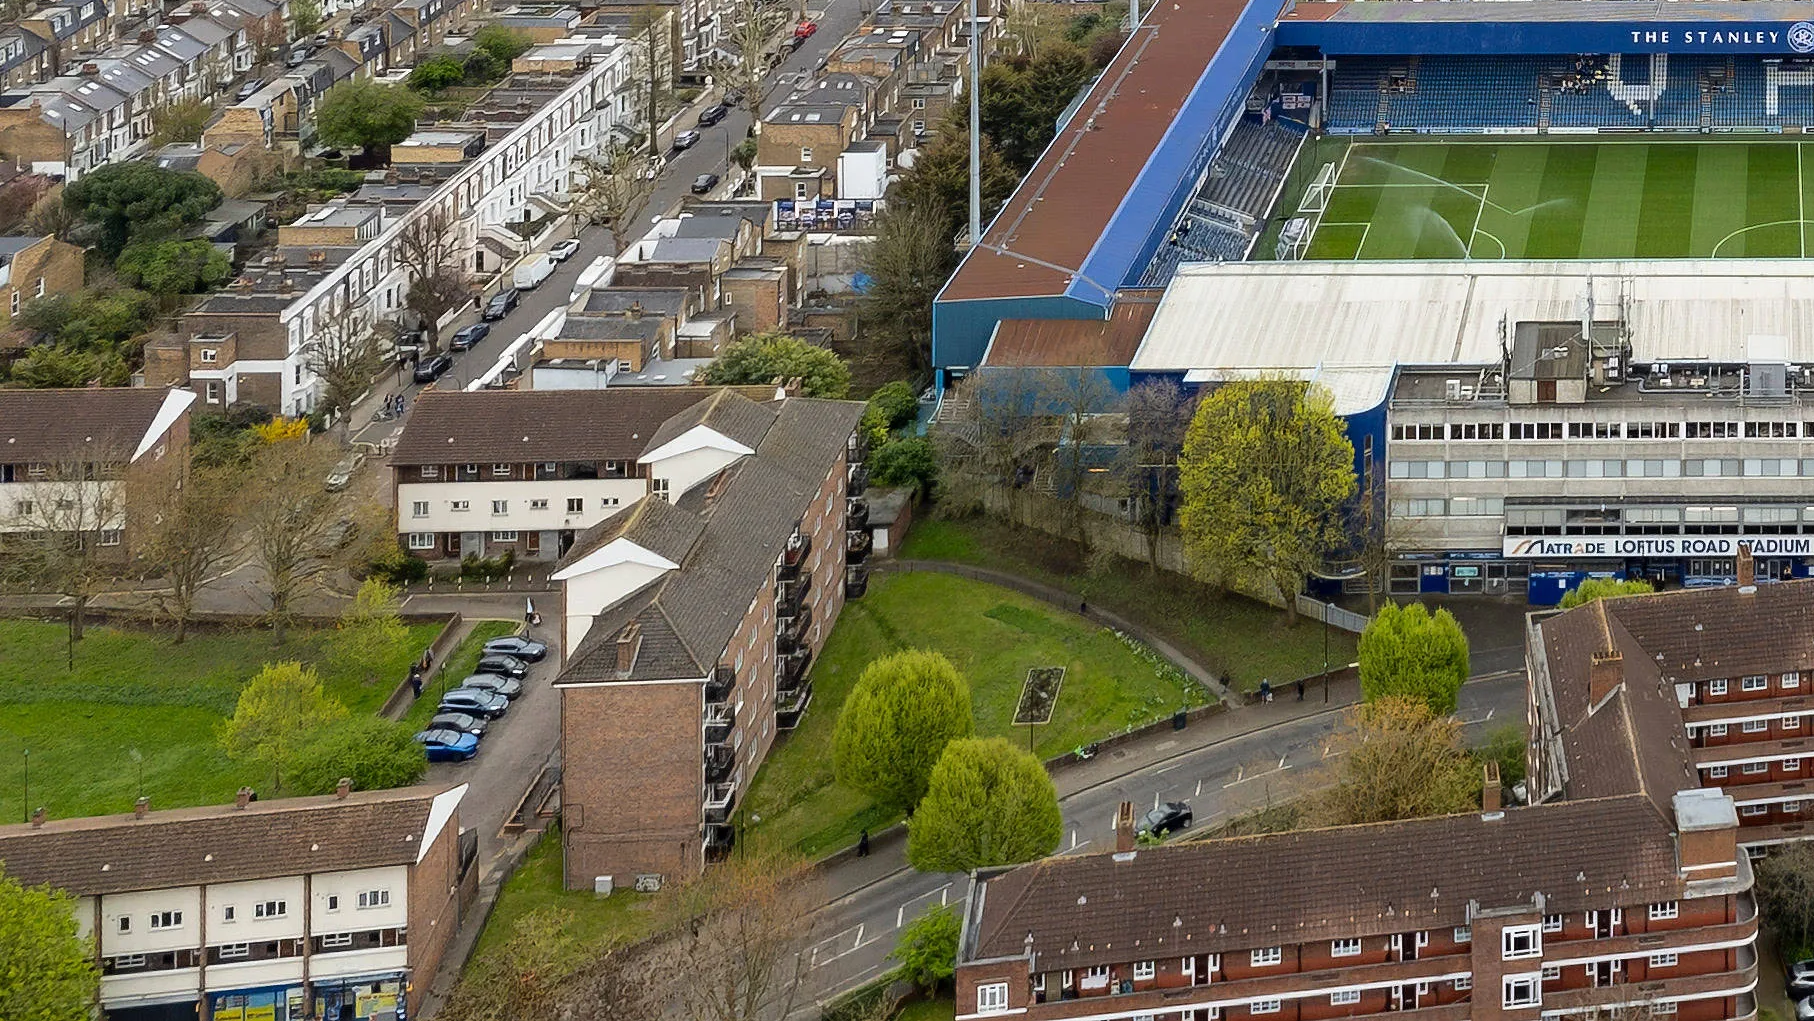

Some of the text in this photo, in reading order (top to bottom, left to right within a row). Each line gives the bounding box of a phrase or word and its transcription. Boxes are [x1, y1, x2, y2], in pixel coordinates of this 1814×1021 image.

[1631, 31, 1669, 43] THE
[1684, 31, 1779, 43] STANLEY
[1615, 539, 1675, 554] LOFTUS
[1681, 539, 1731, 554] ROAD
